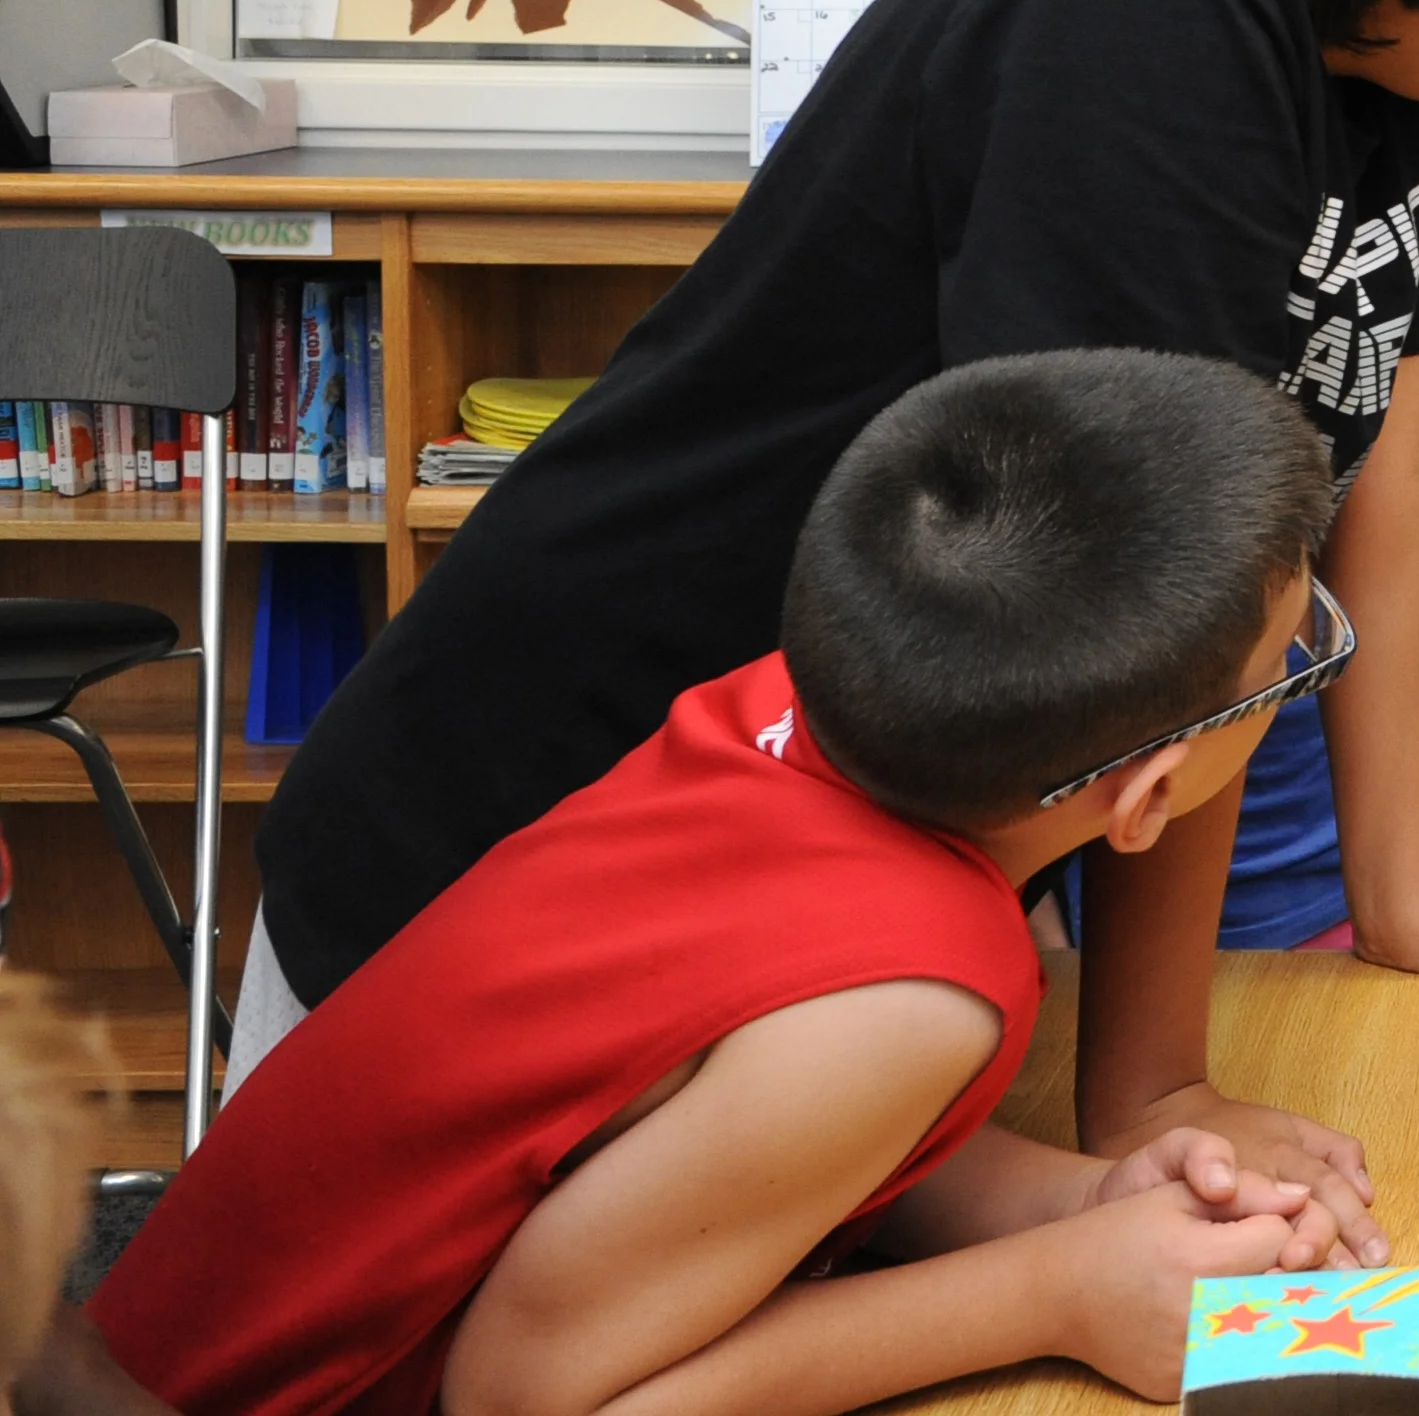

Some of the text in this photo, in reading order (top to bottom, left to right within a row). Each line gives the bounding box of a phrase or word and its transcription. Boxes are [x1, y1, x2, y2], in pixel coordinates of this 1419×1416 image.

[763, 10, 829, 22] 15 16
[204, 218, 316, 246] BOOKS
[275, 318, 287, 338] who
[272, 340, 287, 376] Rocked
[274, 378, 286, 393] the
[273, 396, 286, 425] World
